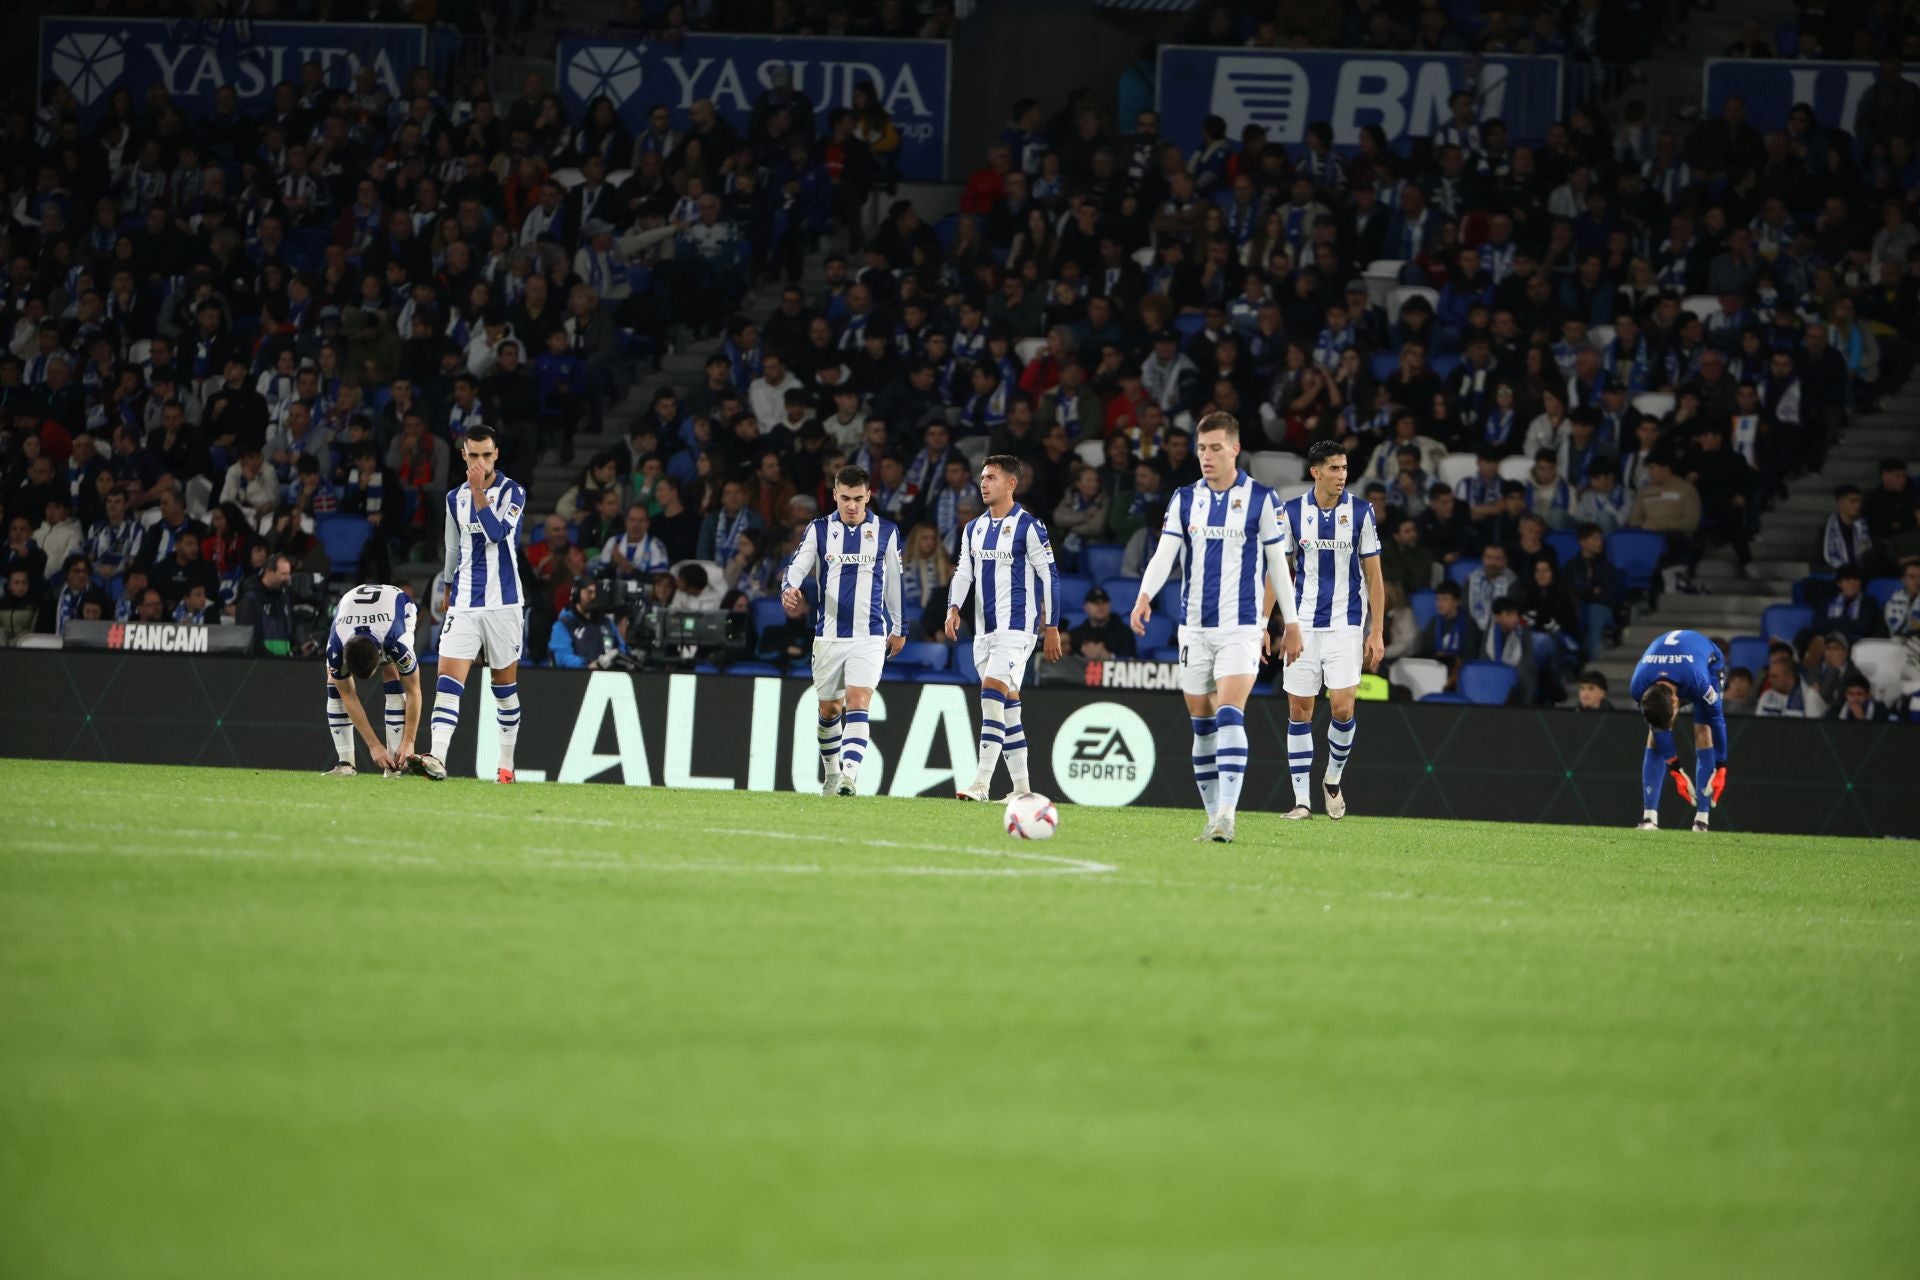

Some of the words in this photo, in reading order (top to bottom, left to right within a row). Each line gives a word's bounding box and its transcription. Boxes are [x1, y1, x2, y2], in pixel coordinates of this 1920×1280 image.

[144, 43, 401, 99] YASUDA
[1330, 59, 1509, 145] BM
[890, 121, 934, 144] oup
[466, 523, 483, 533] YAS
[1202, 527, 1245, 539] YASUDA
[979, 550, 1013, 560] YASUDA
[1314, 540, 1352, 550] YASUDA
[838, 554, 877, 564] YASUDA
[353, 585, 383, 605] 5
[107, 623, 209, 654] #FANCAM
[1180, 645, 1189, 668] 4
[1072, 726, 1135, 763] EA
[1068, 763, 1136, 781] SPORTS
